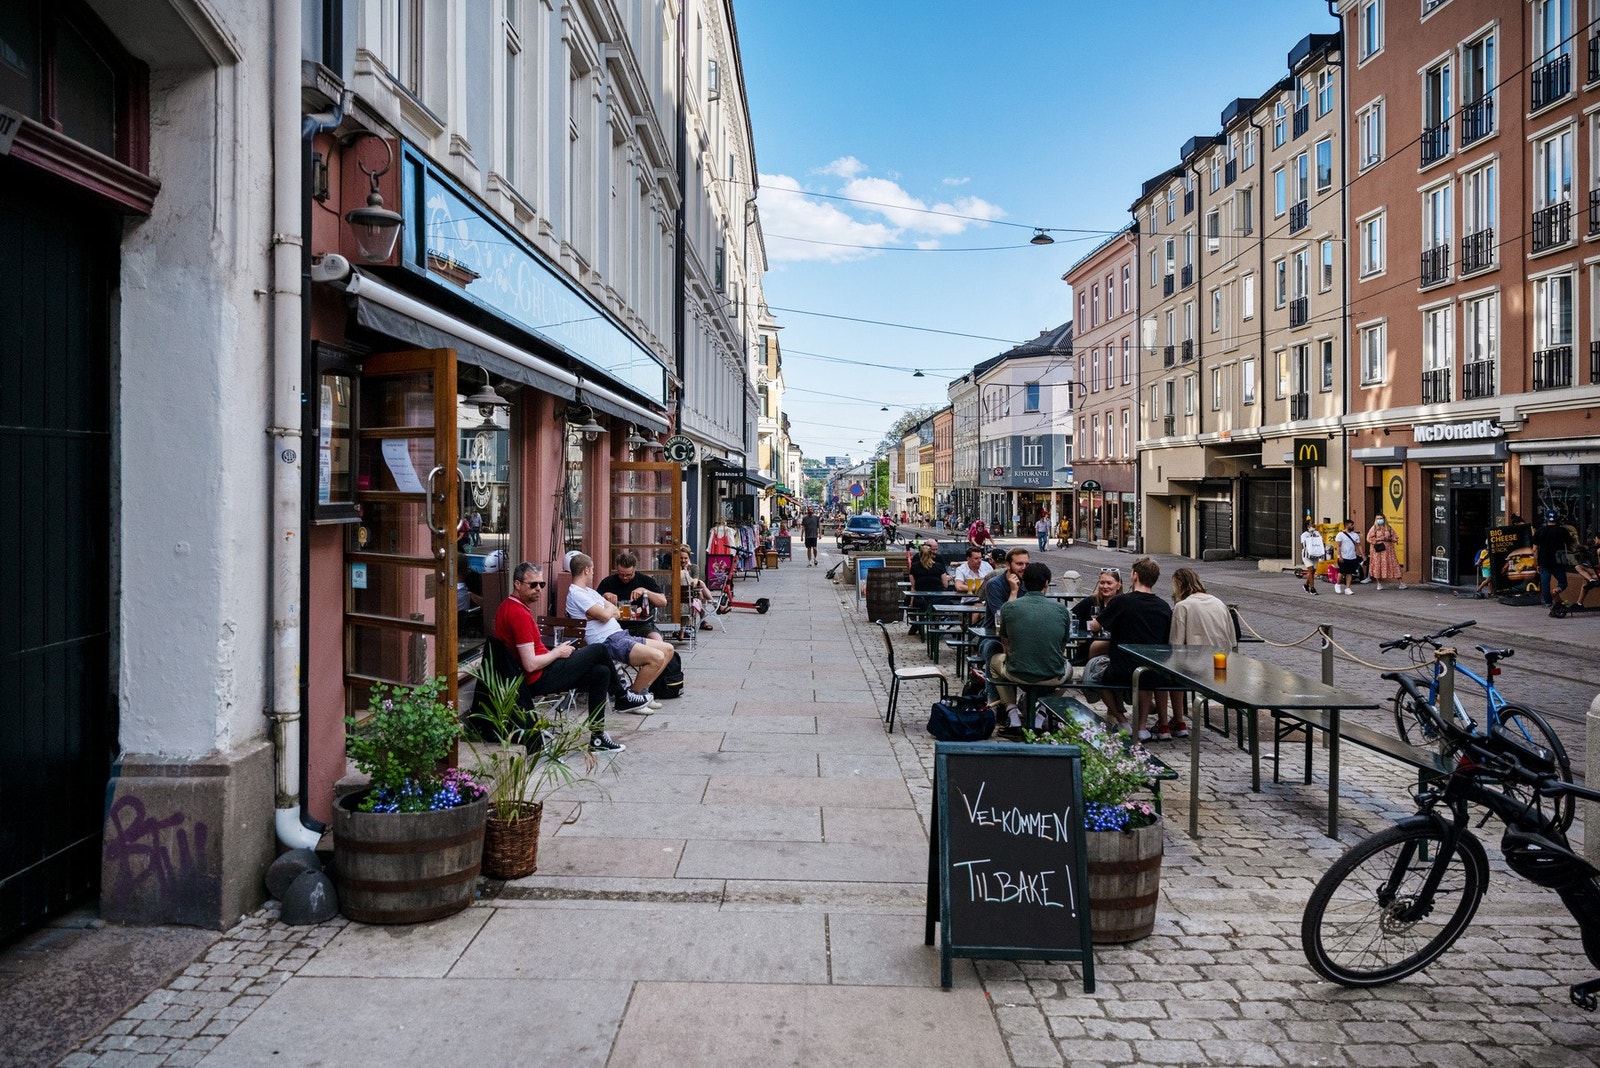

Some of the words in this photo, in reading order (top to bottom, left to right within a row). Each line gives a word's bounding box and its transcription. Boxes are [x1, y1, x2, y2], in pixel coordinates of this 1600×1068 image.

[1414, 420, 1500, 442] McDonald's
[671, 444, 687, 460] G
[1490, 529, 1503, 537] BIG
[1490, 534, 1518, 543] CHEESE
